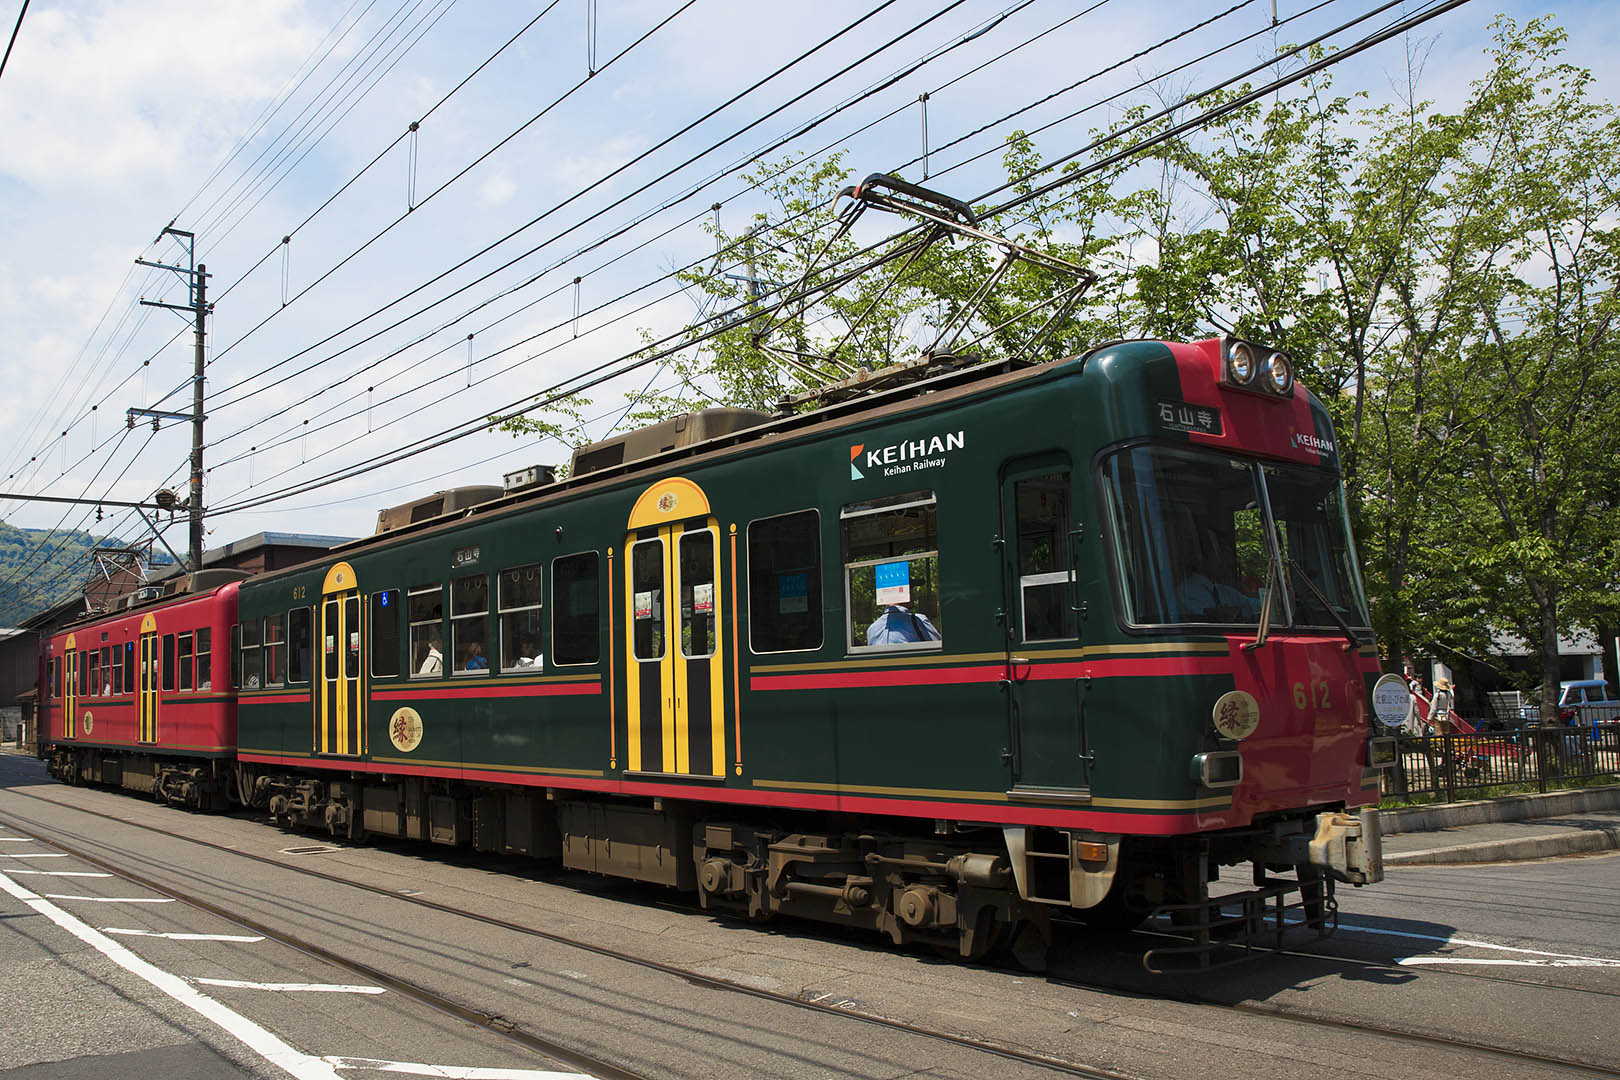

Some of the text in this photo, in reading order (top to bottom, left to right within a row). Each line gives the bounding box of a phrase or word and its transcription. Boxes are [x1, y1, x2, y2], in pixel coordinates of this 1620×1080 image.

[1157, 402, 1212, 429] 石山寺
[884, 457, 946, 476] Keihan Railway
[293, 586, 306, 600] 612
[1293, 681, 1332, 709] 612
